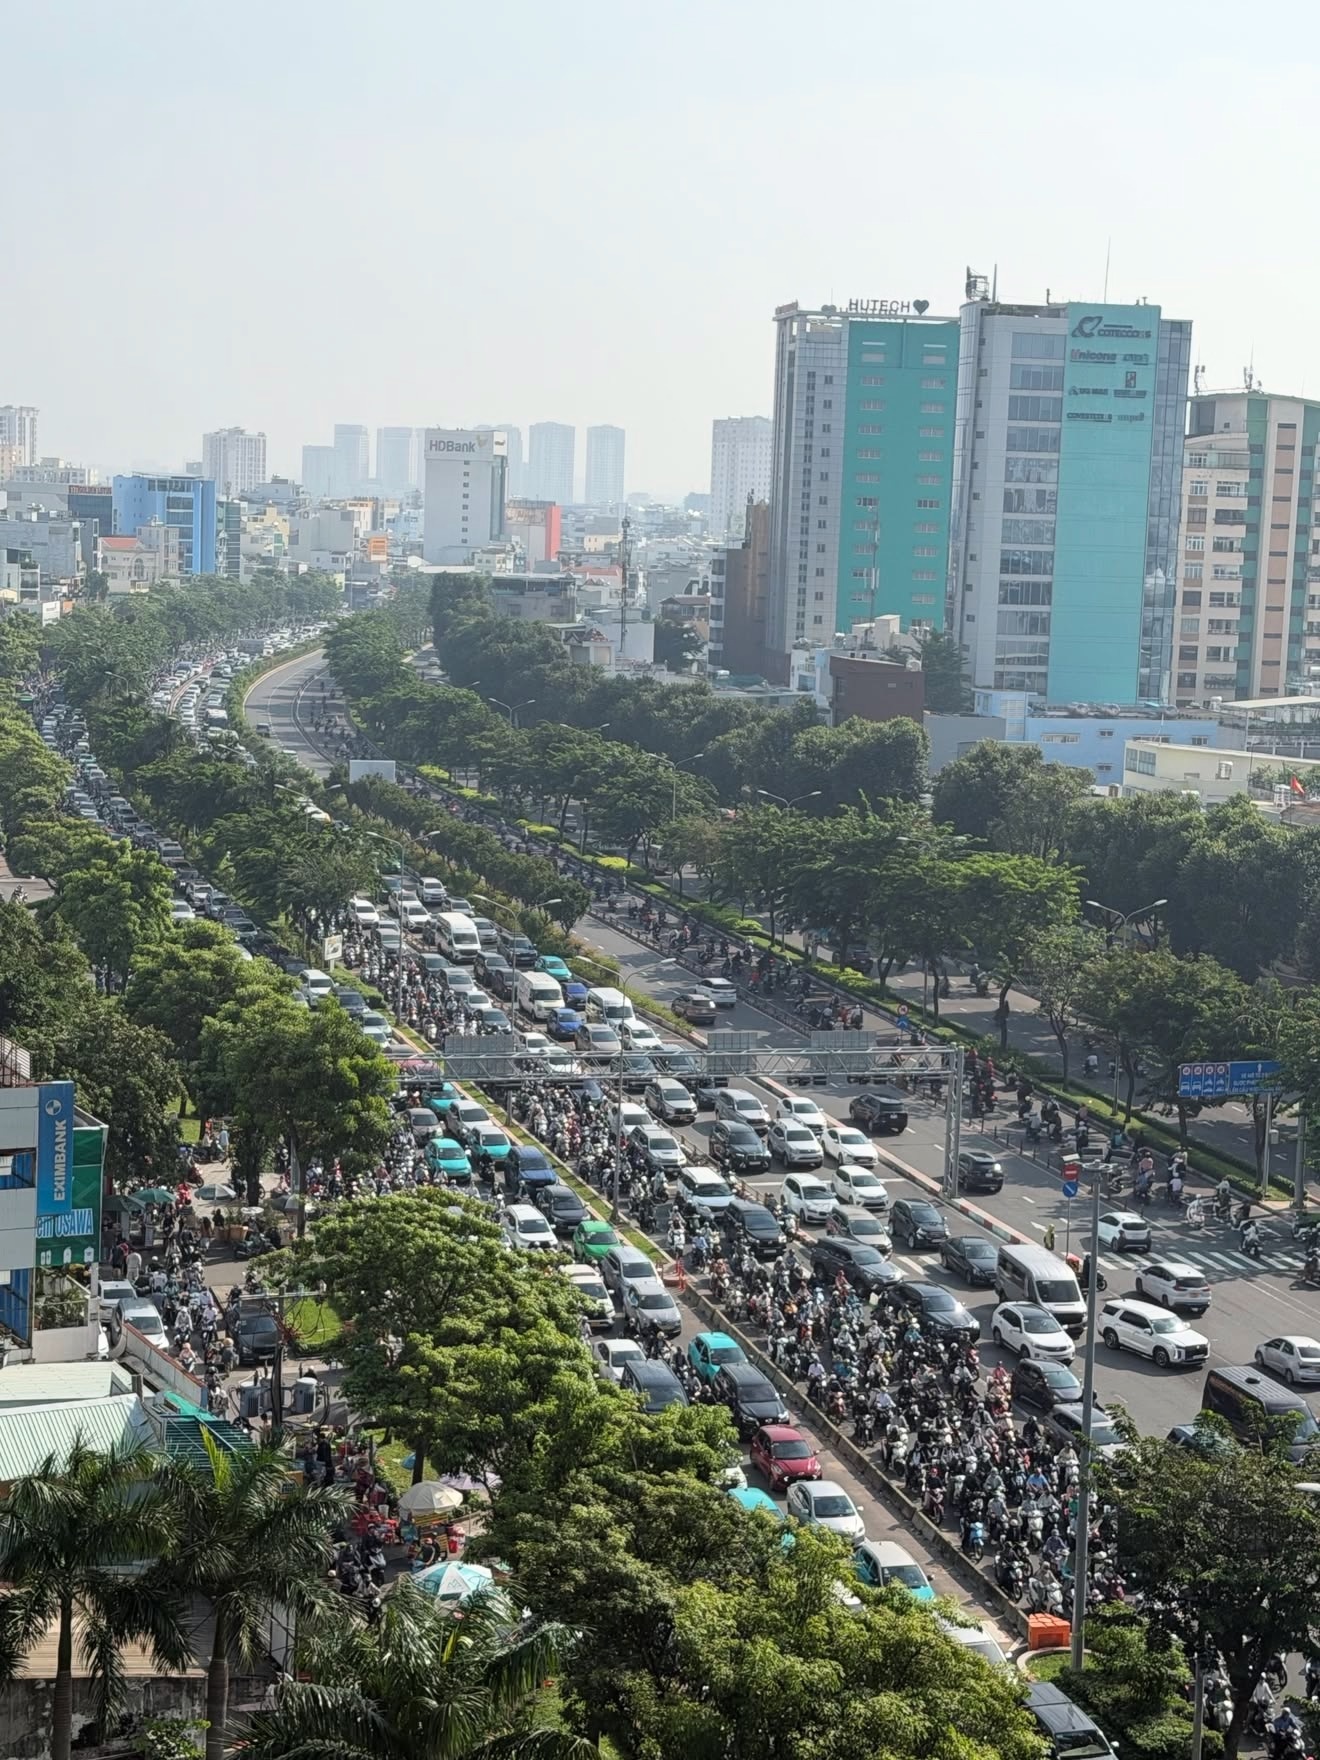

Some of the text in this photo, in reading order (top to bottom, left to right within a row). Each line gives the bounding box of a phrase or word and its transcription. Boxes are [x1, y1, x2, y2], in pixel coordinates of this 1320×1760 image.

[849, 298, 910, 313] HUTECH
[429, 439, 476, 453] HDBank
[53, 1119, 67, 1201] EXIMBANK
[54, 1207, 94, 1238] USAWA
